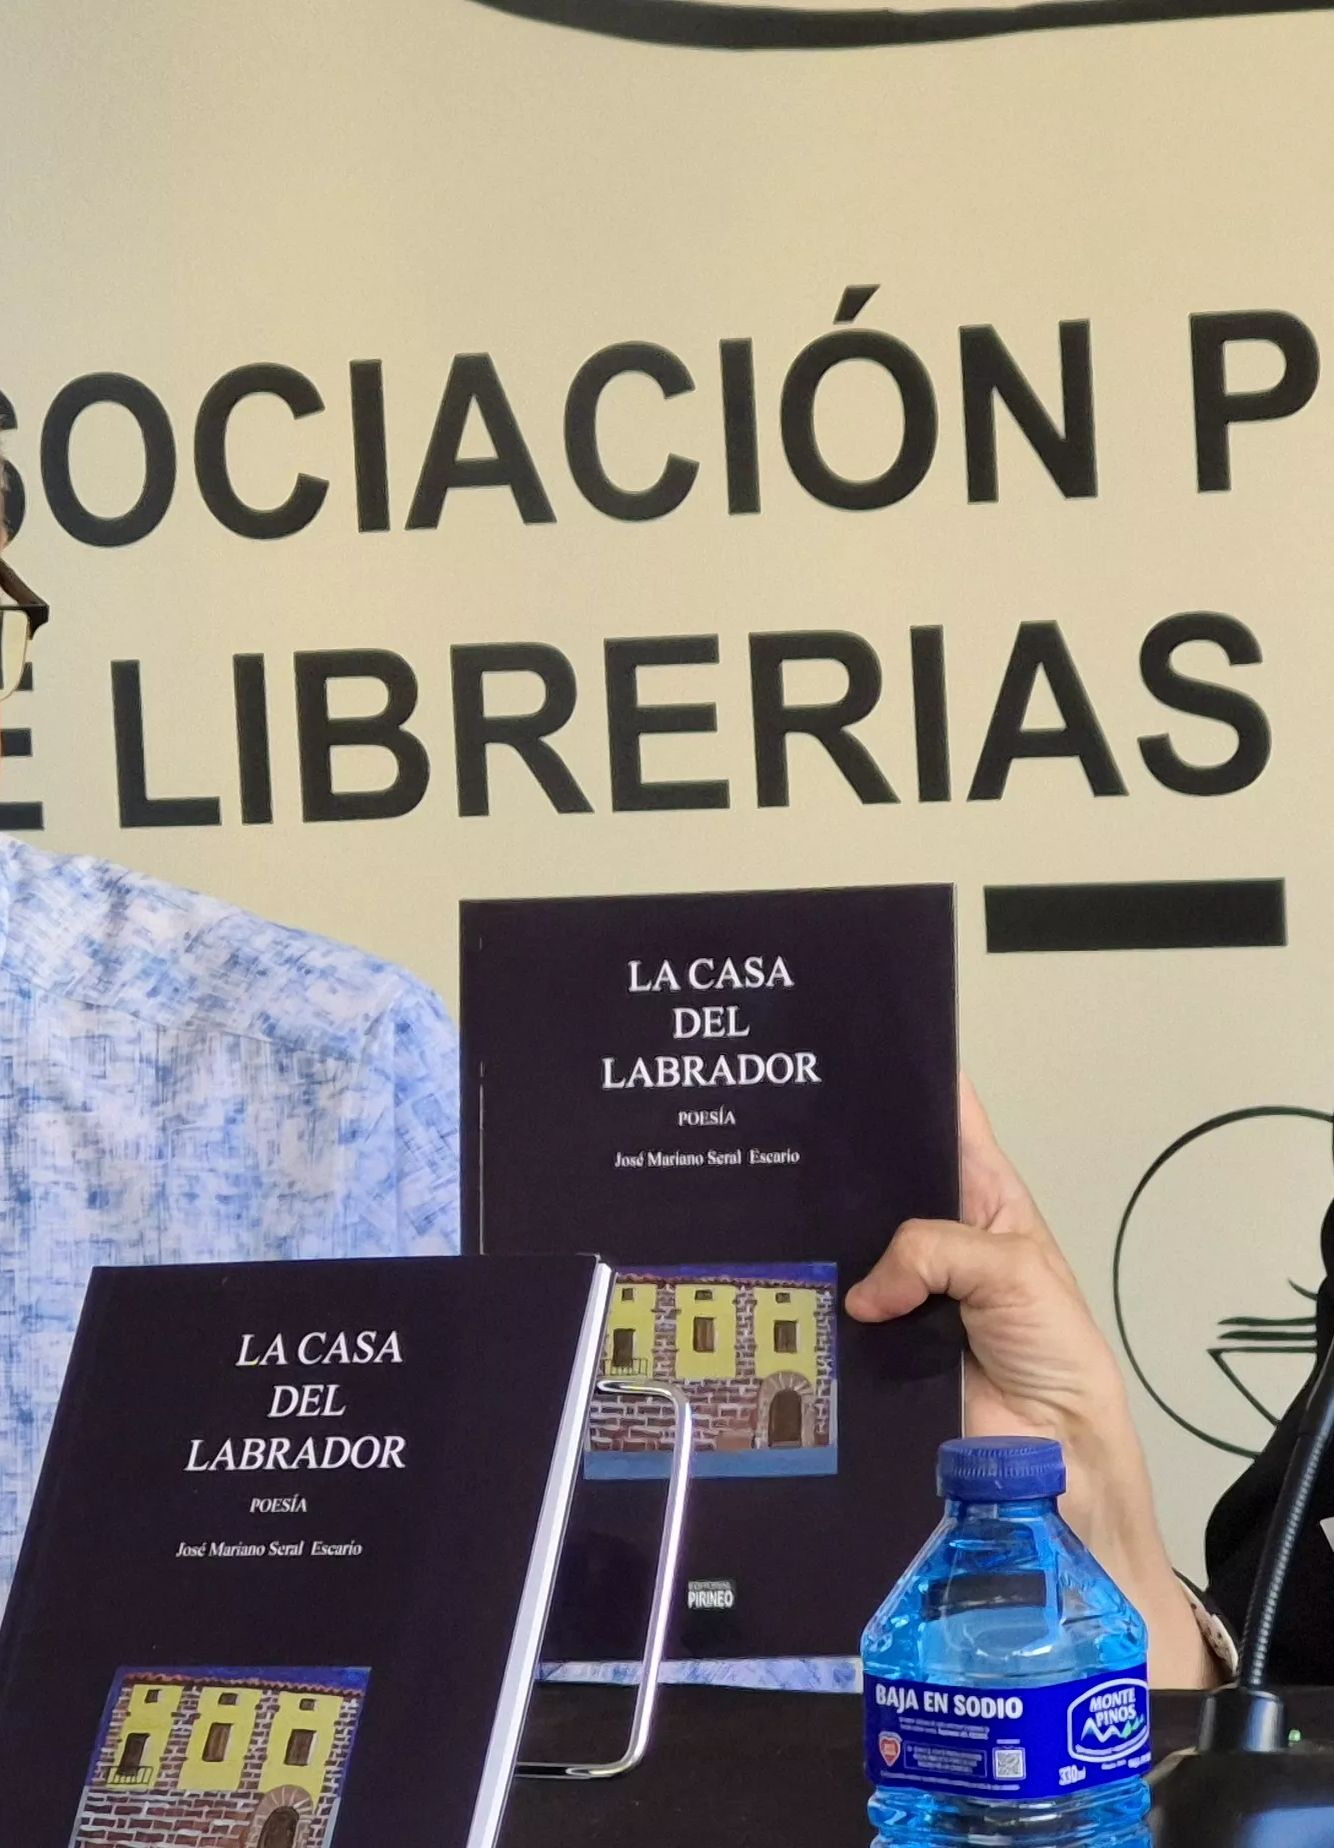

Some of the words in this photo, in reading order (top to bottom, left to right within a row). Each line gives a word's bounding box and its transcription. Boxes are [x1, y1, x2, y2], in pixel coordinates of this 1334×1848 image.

[110, 611, 1272, 829] LIBRERIAS
[628, 959, 680, 992] LA
[688, 955, 795, 990] CASA
[673, 1005, 750, 1039] DEL
[602, 1051, 822, 1089] LABRADOR
[677, 1104, 736, 1127] POESÍA
[614, 1150, 645, 1168] José
[647, 1150, 705, 1167] Mariano
[707, 1147, 742, 1166] Seral
[749, 1148, 801, 1165] Escario
[235, 1333, 288, 1367] LA
[297, 1330, 403, 1365] CASA
[267, 1384, 346, 1418] DEL
[184, 1435, 406, 1472] LABRADOR
[249, 1493, 308, 1513] POESÍA
[175, 1541, 207, 1558] José
[208, 1541, 266, 1557] Mariano
[268, 1540, 304, 1556] Seral
[310, 1539, 363, 1556] Escario
[875, 1683, 919, 1714] BAJA
[923, 1690, 949, 1714] EN
[953, 1694, 1024, 1720] SODIO
[1088, 1686, 1137, 1713] MONTE
[1094, 1703, 1137, 1728] PINOS
